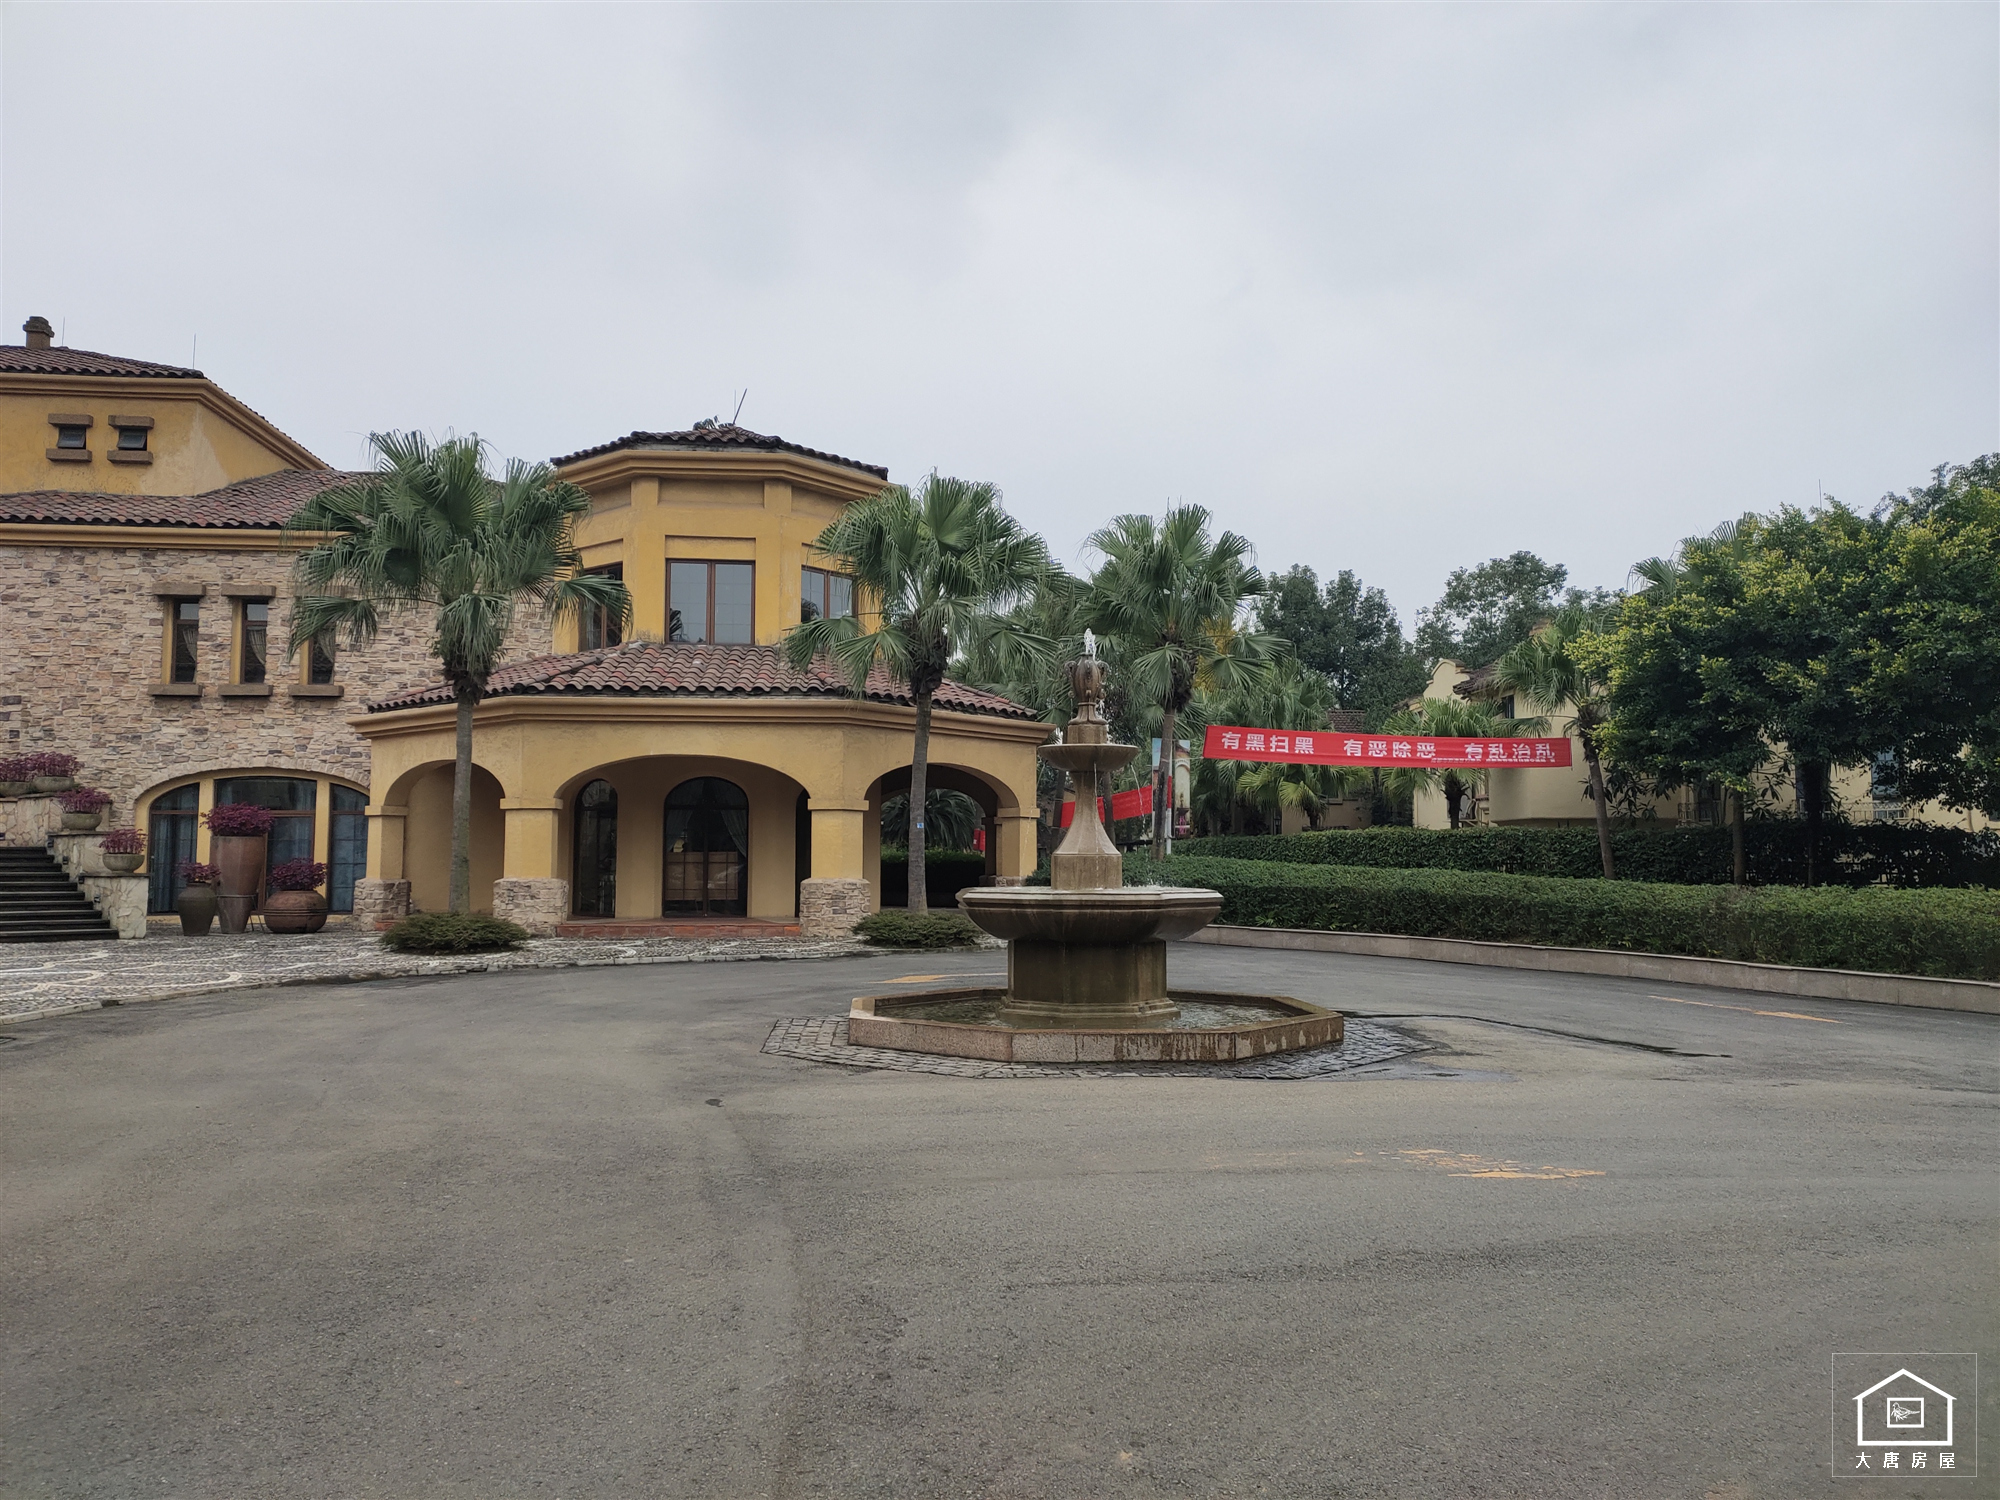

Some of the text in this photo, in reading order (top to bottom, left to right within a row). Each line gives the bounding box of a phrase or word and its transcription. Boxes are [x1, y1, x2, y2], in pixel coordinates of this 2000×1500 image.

[1221, 731, 1556, 761] 有黑扫黑 有恶除恶 有乱治乱
